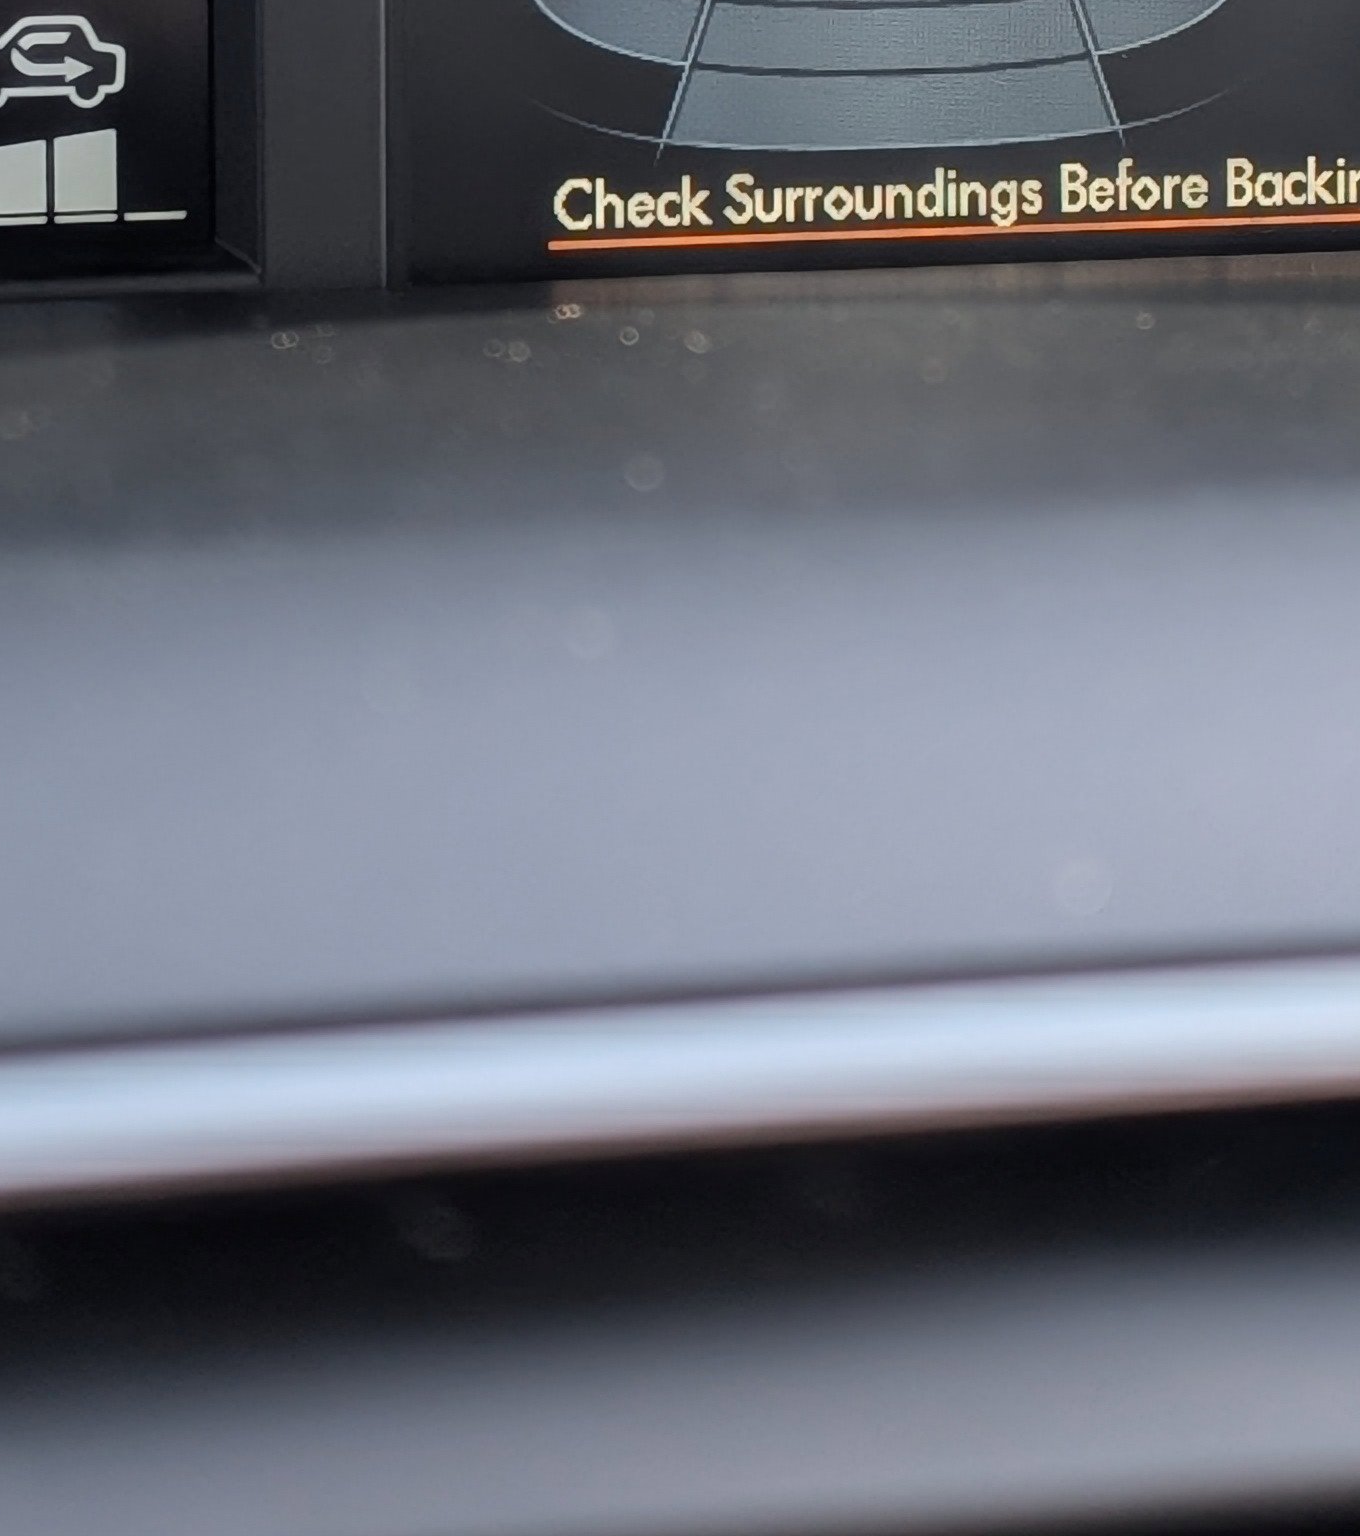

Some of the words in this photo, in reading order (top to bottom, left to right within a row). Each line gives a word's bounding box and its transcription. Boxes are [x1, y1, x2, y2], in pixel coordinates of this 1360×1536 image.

[552, 174, 712, 234] Check
[723, 167, 1043, 229] Surroundings
[1060, 157, 1210, 215] Before
